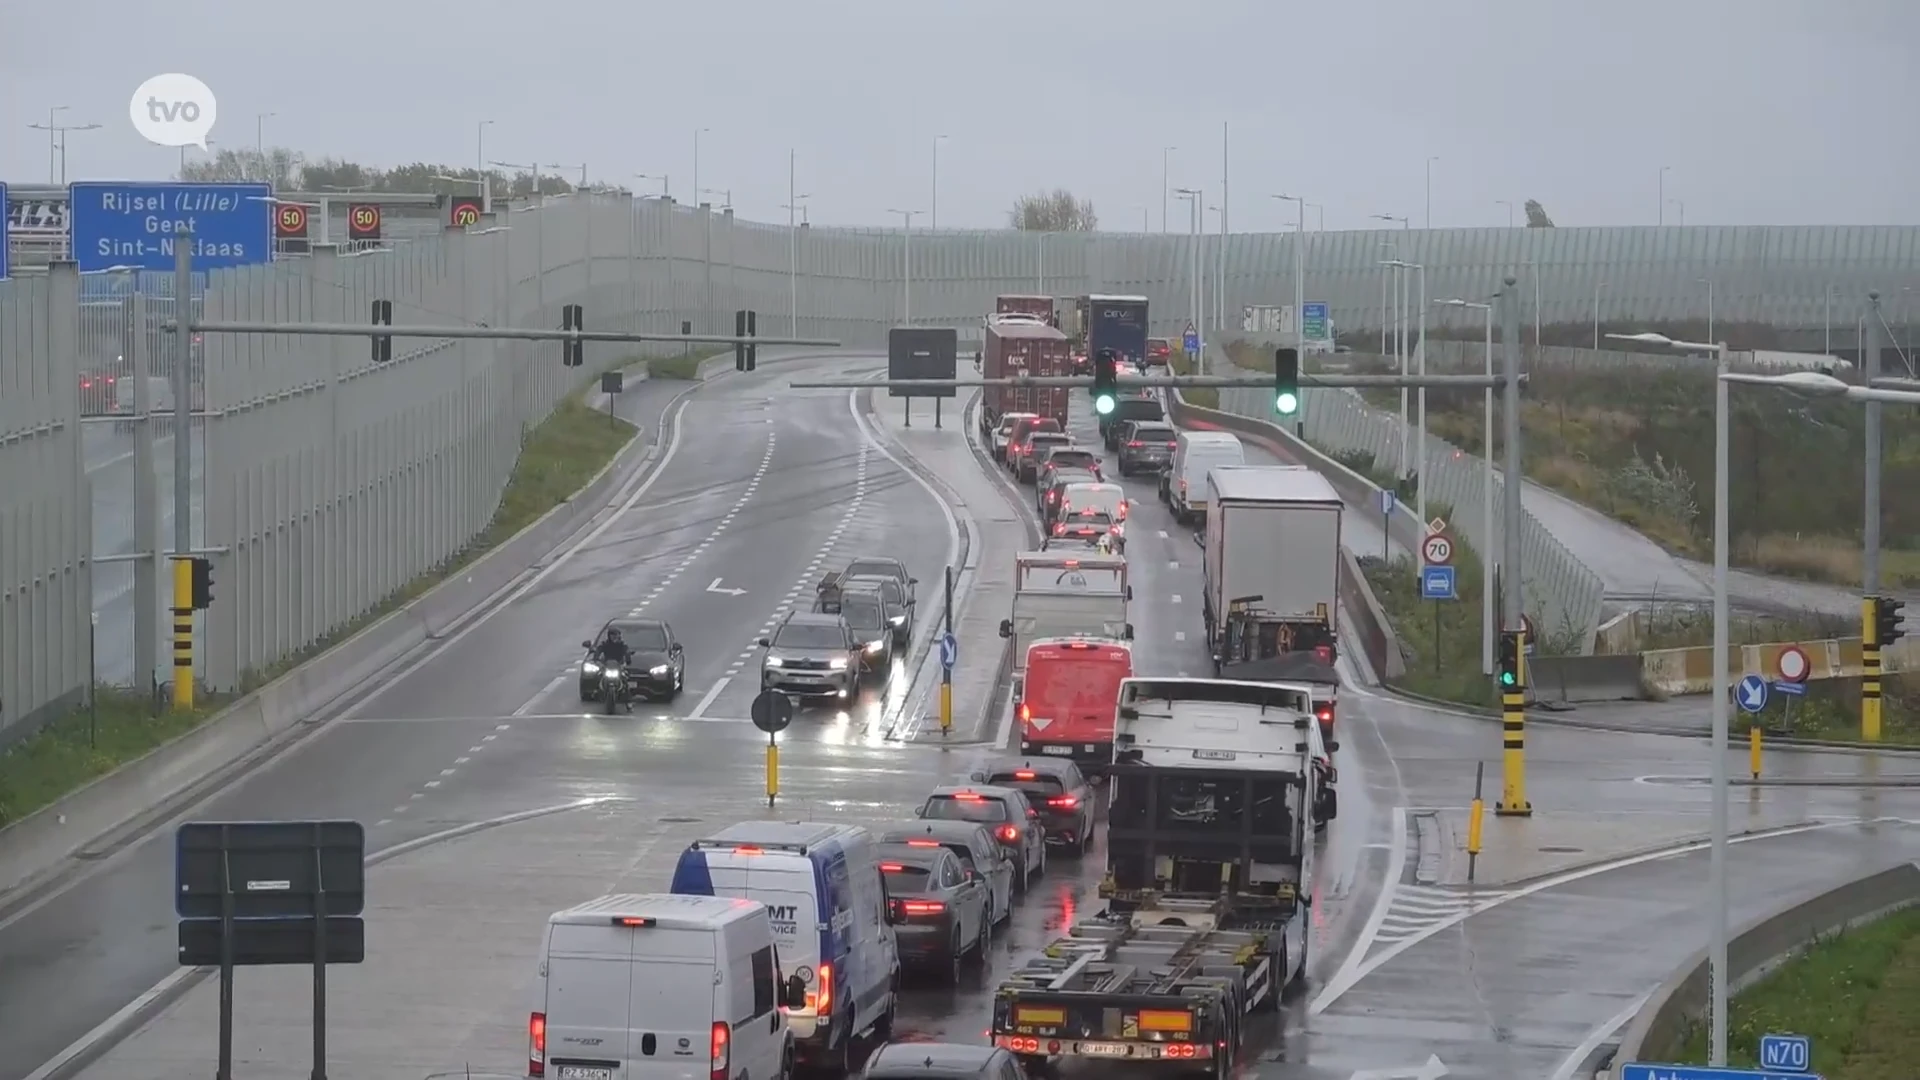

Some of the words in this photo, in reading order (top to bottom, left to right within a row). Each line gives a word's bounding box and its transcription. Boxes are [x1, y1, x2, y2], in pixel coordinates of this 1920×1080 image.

[103, 192, 165, 214] Rijsel
[175, 192, 239, 212] (Lille)
[145, 216, 196, 233] Gent
[283, 211, 299, 225] 50
[356, 211, 373, 225] 50
[459, 211, 475, 226] 70
[98, 238, 243, 256] Sint-Nlaas
[1104, 310, 1133, 318] CEV
[1429, 543, 1448, 557] 70
[766, 905, 797, 920] MT
[1017, 1025, 1033, 1033] 462
[1173, 1032, 1189, 1040] 462
[1767, 1041, 1804, 1065] N70
